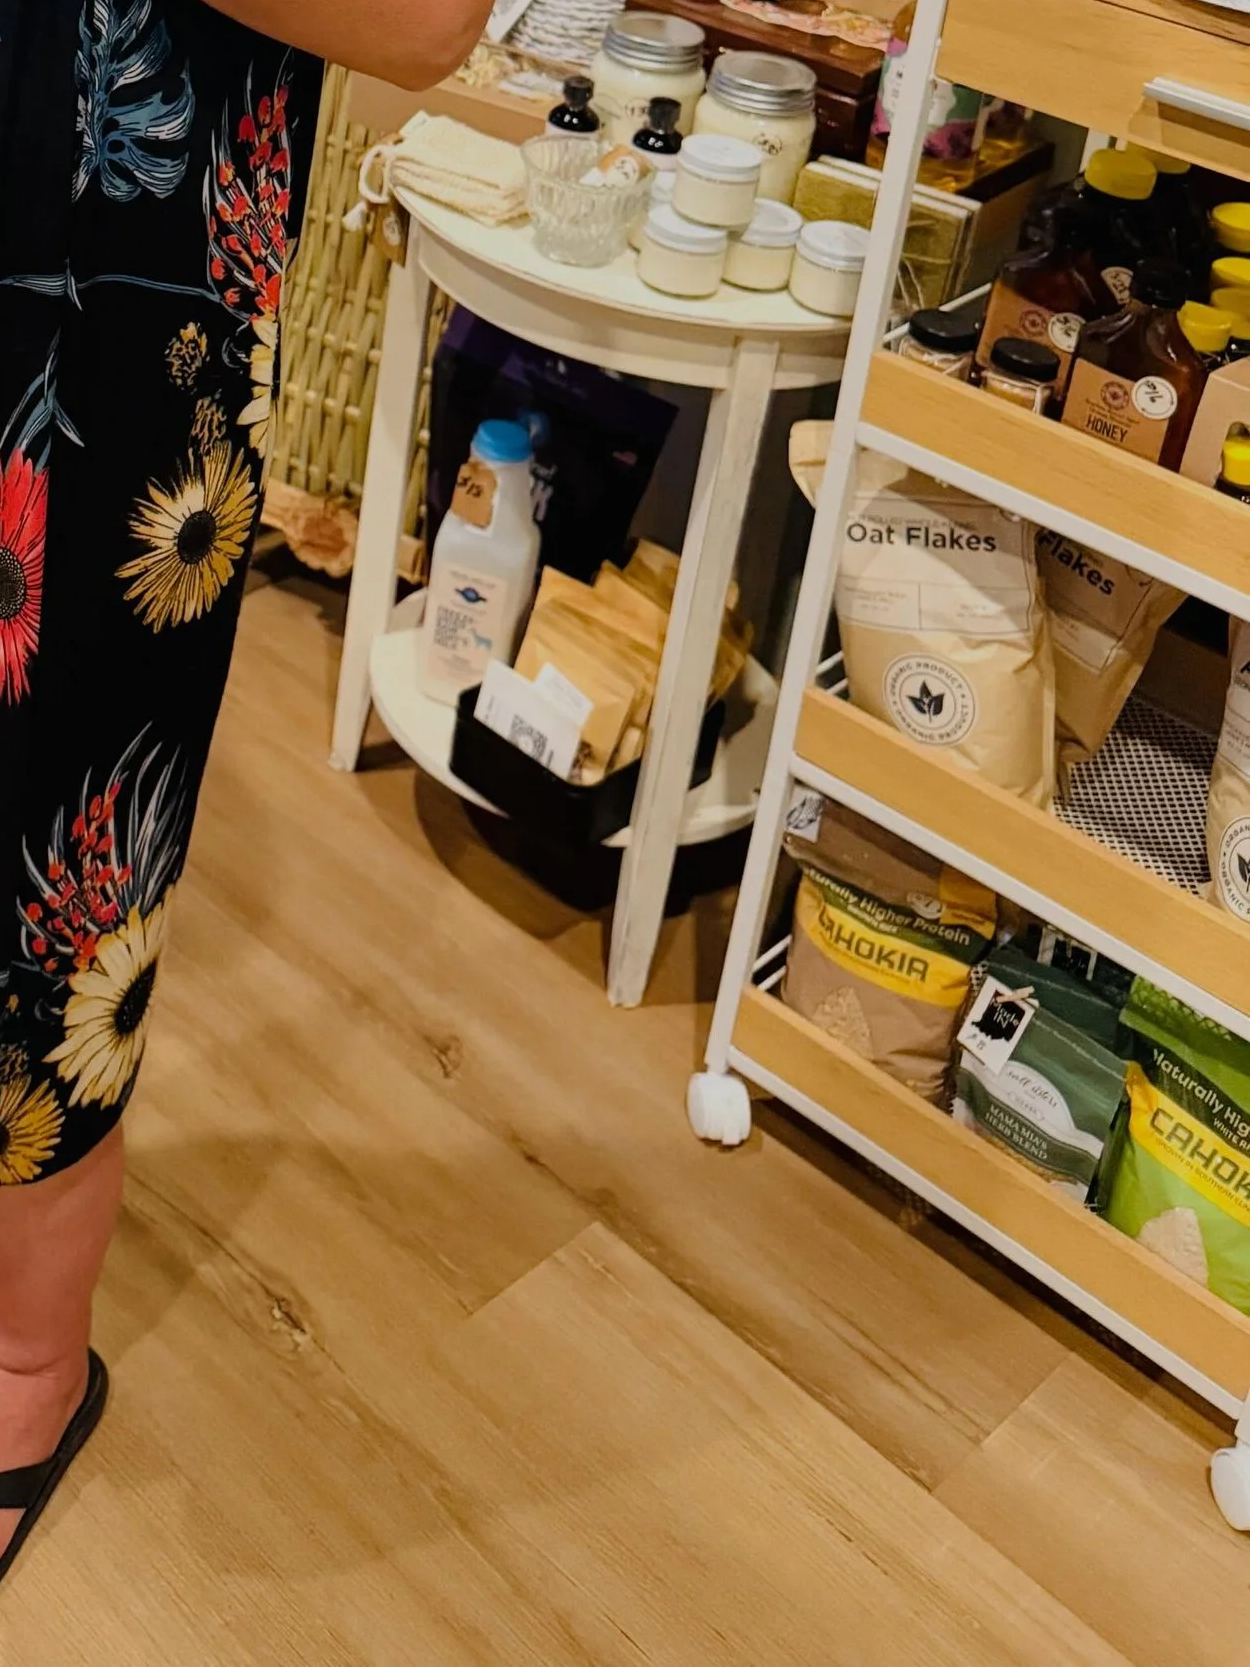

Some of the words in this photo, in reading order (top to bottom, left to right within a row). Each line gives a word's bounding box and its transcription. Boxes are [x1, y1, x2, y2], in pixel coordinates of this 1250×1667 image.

[1086, 413, 1129, 443] HONEY
[846, 522, 895, 545] Oat
[905, 526, 998, 553] Flakes
[1037, 529, 1116, 596] Flakes
[860, 896, 910, 926] Higher
[913, 917, 971, 946] Protein
[1153, 1047, 1225, 1115] Naturally
[985, 1112, 1011, 1139] HERB
[1011, 1131, 1049, 1162] BLEND
[989, 1103, 1022, 1133] MAMA
[1213, 1117, 1239, 1144] WHITE
